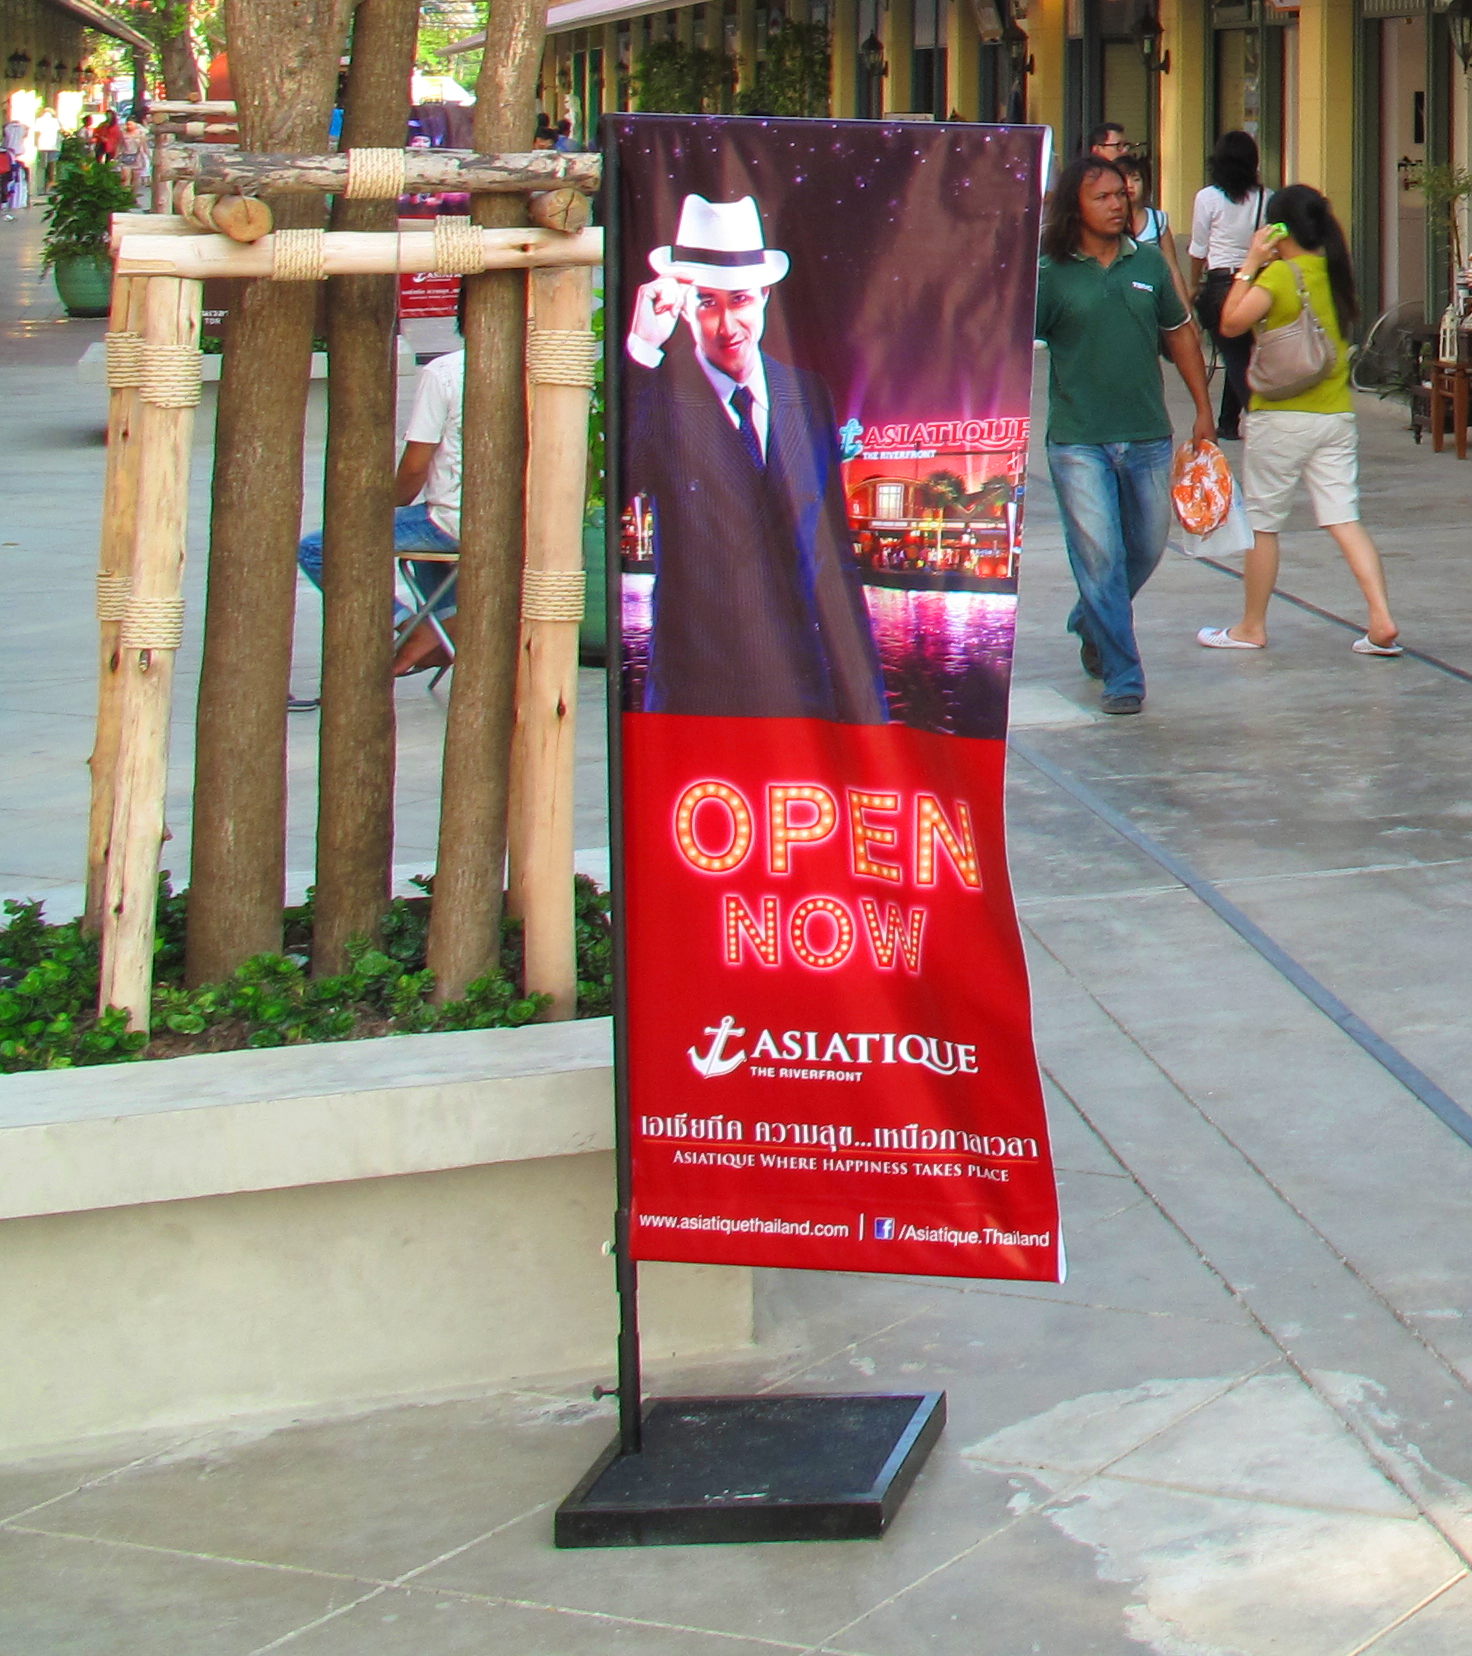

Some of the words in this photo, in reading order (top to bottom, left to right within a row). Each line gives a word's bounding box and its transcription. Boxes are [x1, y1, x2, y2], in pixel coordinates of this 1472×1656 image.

[863, 416, 1030, 451] ASIATIQUE
[673, 778, 983, 890] OPEN
[724, 894, 926, 975] NOW
[750, 1029, 980, 1075] ASIATIQUE
[750, 1066, 776, 1079] THE
[779, 1067, 863, 1082] RIVERFRONT
[640, 1112, 743, 1140] เอเชียทีค
[760, 1153, 817, 1170] WHERE
[823, 1157, 908, 1175] HAPPINESS
[912, 1162, 962, 1177] TAKES
[968, 1164, 1009, 1182] PLACE
[639, 1212, 849, 1238] www.asiatiquethailand.com
[898, 1224, 1051, 1248] /Asiatique.Thailand
